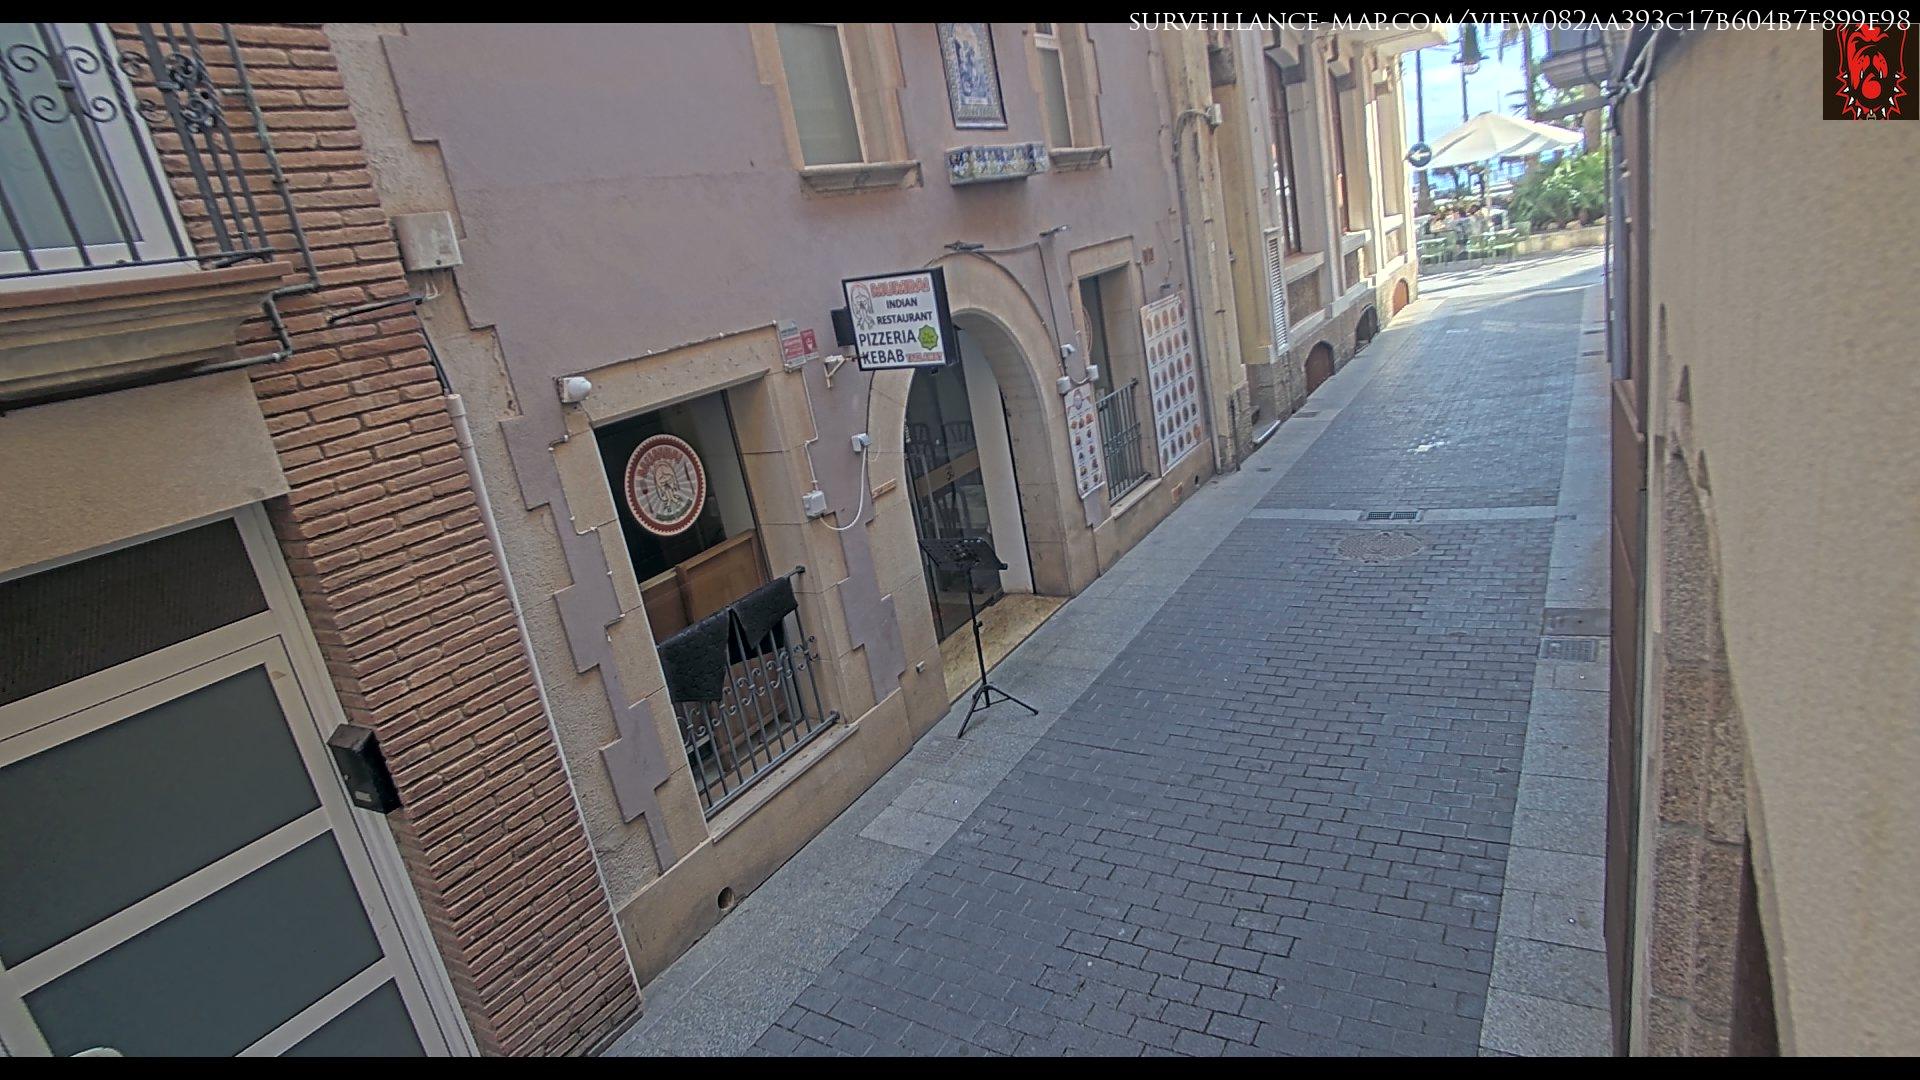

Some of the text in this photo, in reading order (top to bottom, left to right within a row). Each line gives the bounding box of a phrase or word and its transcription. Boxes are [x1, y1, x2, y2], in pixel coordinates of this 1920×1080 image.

[886, 297, 918, 310] INDIAN
[876, 311, 933, 325] RESTAURANT
[859, 329, 917, 347] PIZZERIA
[861, 349, 905, 365] KEBAB
